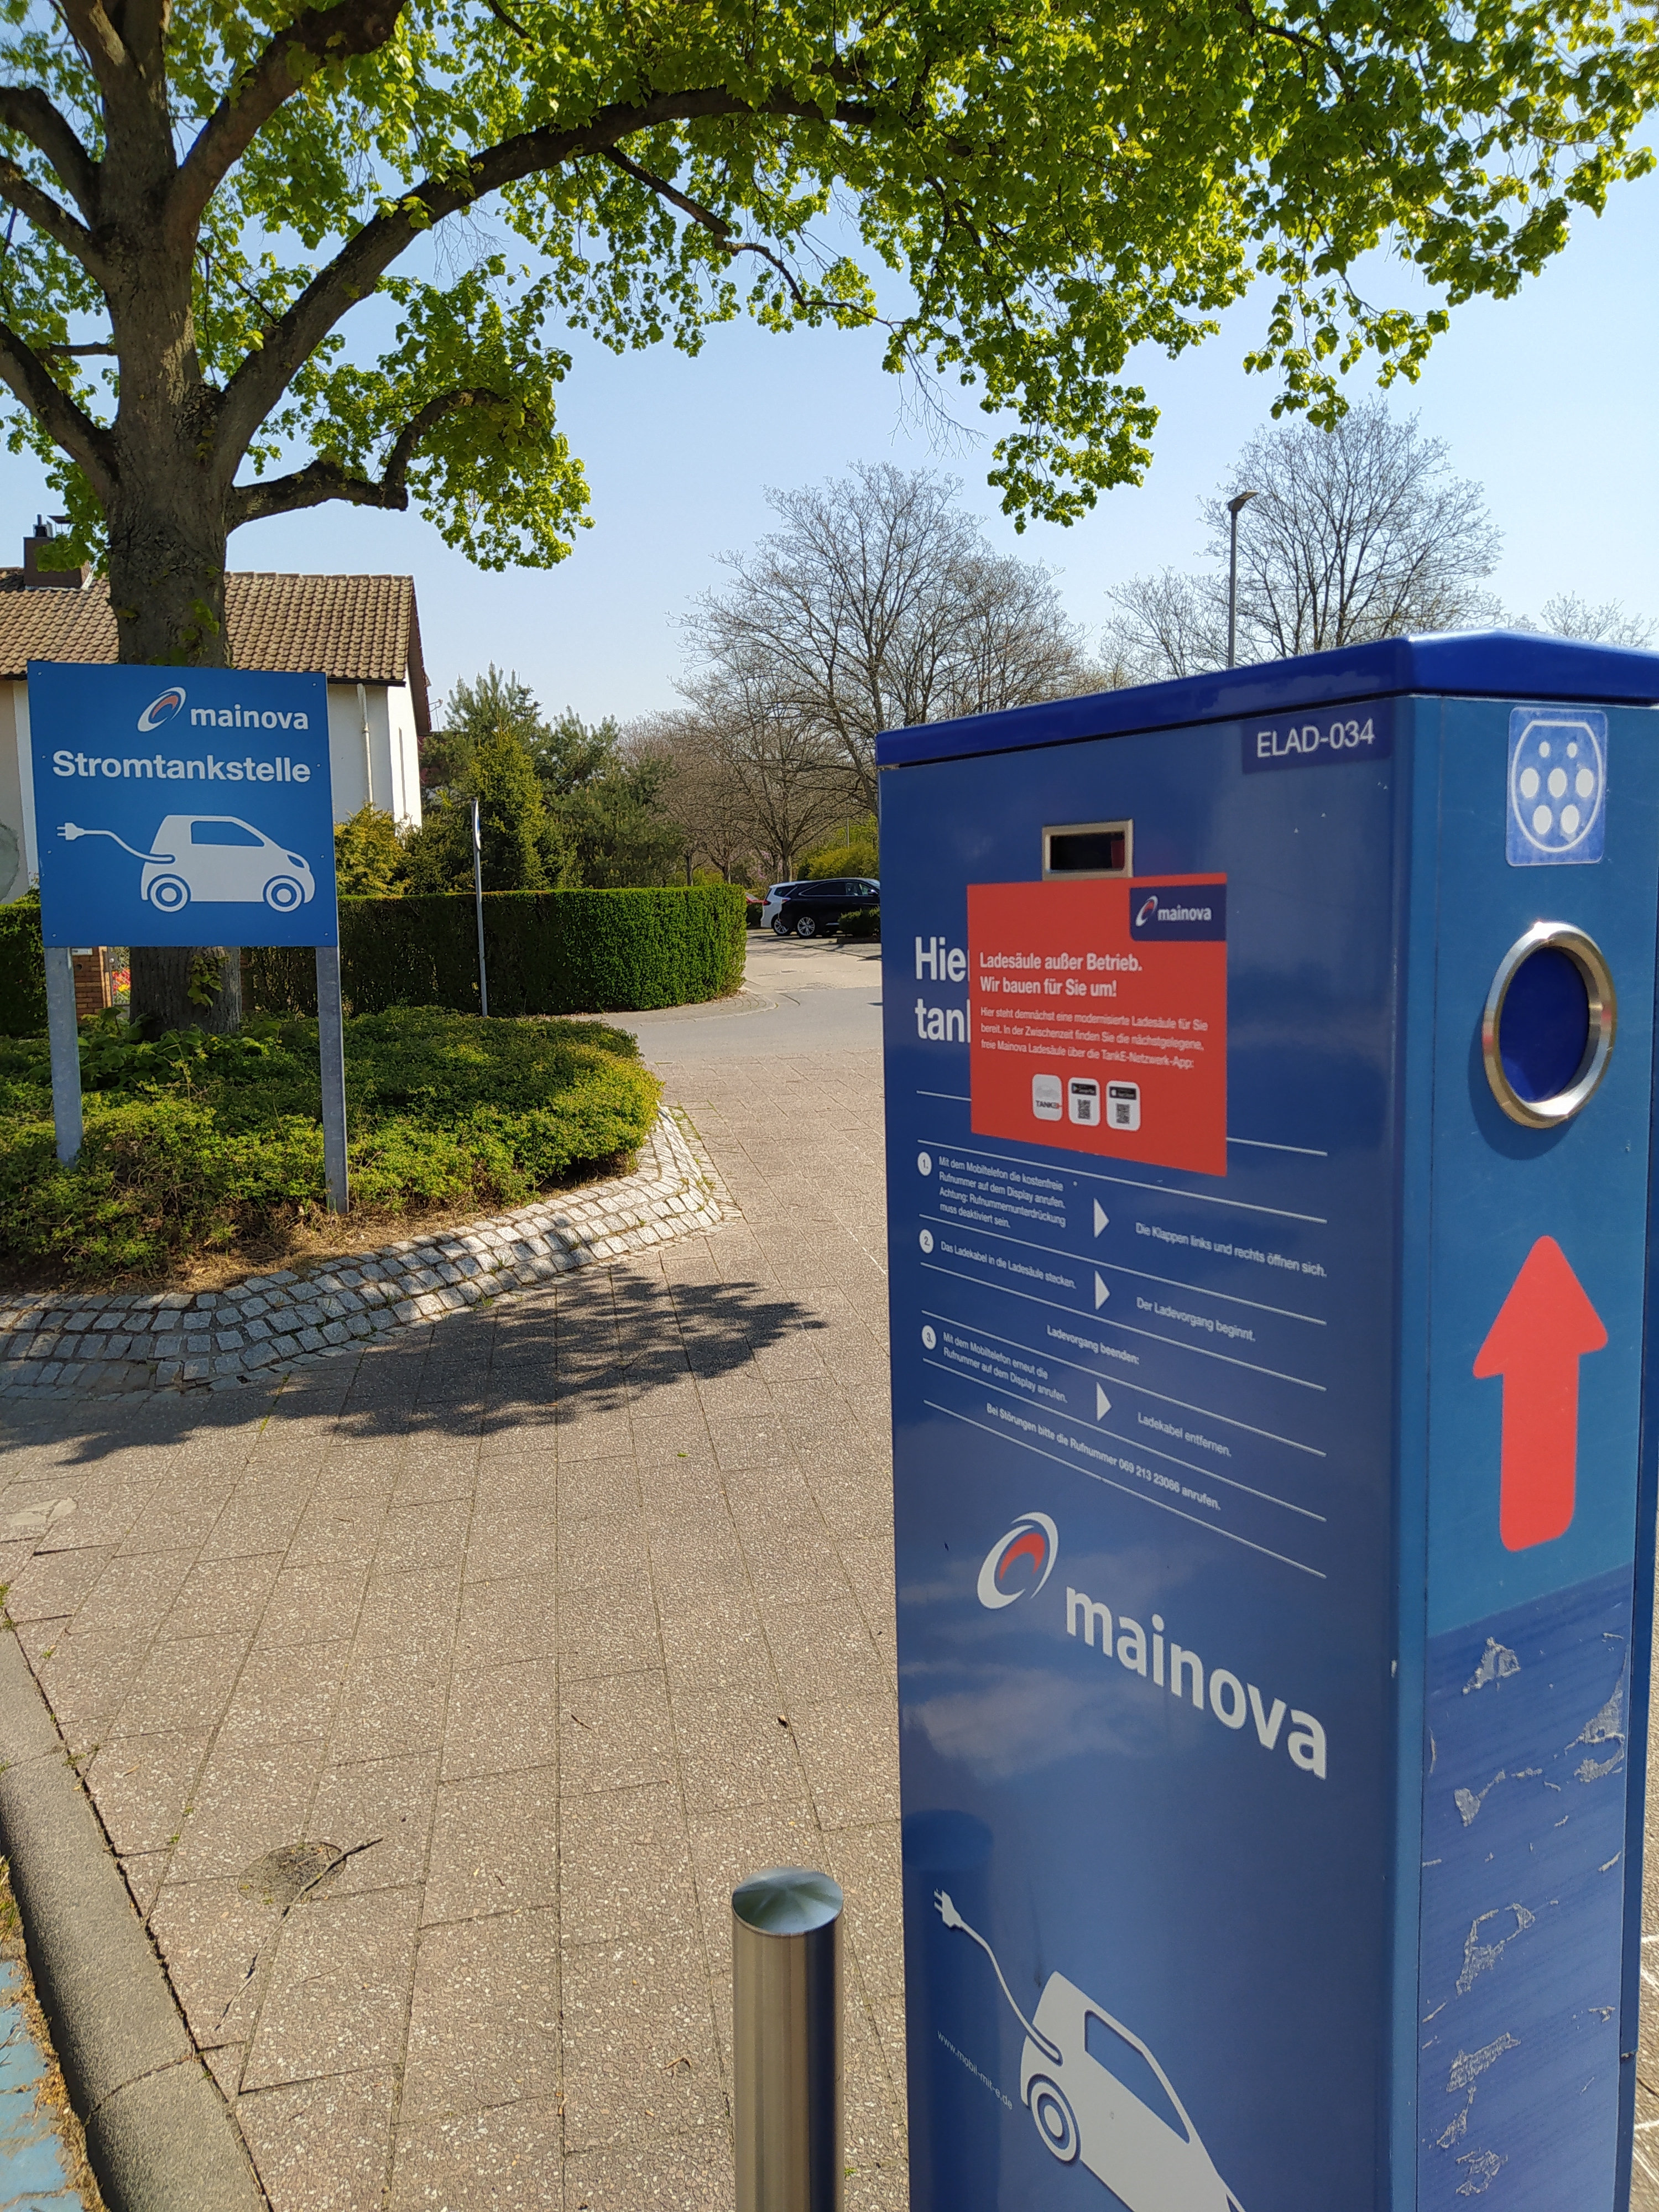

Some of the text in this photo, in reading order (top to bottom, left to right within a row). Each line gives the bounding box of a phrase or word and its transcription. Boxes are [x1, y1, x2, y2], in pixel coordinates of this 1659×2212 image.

[190, 704, 309, 729] mainova
[1256, 719, 1375, 758] ELAD-034
[53, 750, 311, 782] Stromtankstelle
[1158, 904, 1211, 921] mainova
[915, 937, 970, 982] Hie
[980, 952, 1142, 971] Ladesäule außer Betrieb.
[980, 976, 1117, 997] Wir bauen für Sie um!
[980, 1007, 1208, 1031] Hier steht demnächst eine modernisierte Ladesäule für Sie
[981, 1023, 1002, 1034] bereit.
[1004, 1024, 1010, 1034] In
[1012, 1025, 1023, 1035] der
[1025, 1026, 1073, 1039] Zwischenzeit
[1076, 1030, 1100, 1041] finden
[1102, 1031, 1114, 1042] Sie
[1117, 1033, 1130, 1044] die
[981, 1039, 996, 1049] freie
[998, 1040, 1027, 1052] Mainova
[1029, 1043, 1066, 1056] Ladesäule
[1068, 1047, 1086, 1057] über
[1087, 1048, 1100, 1059] die
[922, 1159, 929, 1169] 1.
[940, 1156, 1063, 1192] Mit dem Mobiltelefon die kostenfreie
[940, 1171, 1066, 1209] Rufnummer auf dem Display anrufen.
[940, 1187, 1066, 1228] Achtung: Rufnummernunterdrückung
[940, 1203, 1011, 1228] muss deaktiviert sein.
[924, 1236, 930, 1246] 2.
[1136, 1222, 1327, 1277] Die Klappen links und rechts öffnen sich.
[941, 1241, 1077, 1290] Das Ladekabel in die Ladesäule stecken.
[926, 1332, 933, 1343] 3.
[1136, 1297, 1256, 1342] Der Ladevorgang beginnt.
[943, 1332, 1048, 1380] Mit dem Mobiltelefon erneut die
[1047, 1324, 1139, 1365] Ladevorgang beenden:
[944, 1347, 1067, 1403] Rufnummer auf dem Display anrufen.
[1138, 1412, 1232, 1457] Ladekabel entfernen.
[987, 1402, 998, 1416] Bei
[1000, 1408, 1036, 1432] Störungen
[1038, 1424, 1055, 1441] bitte
[1057, 1433, 1068, 1447] die
[1071, 1438, 1118, 1466] Rufnummer
[1119, 1458, 1134, 1474] 069
[1136, 1465, 1152, 1481] 213
[1182, 1486, 1221, 1510] anrufen.
[1066, 1587, 1327, 1780] mainova
[938, 2031, 1013, 2110] www.mobil-mit-e.de
